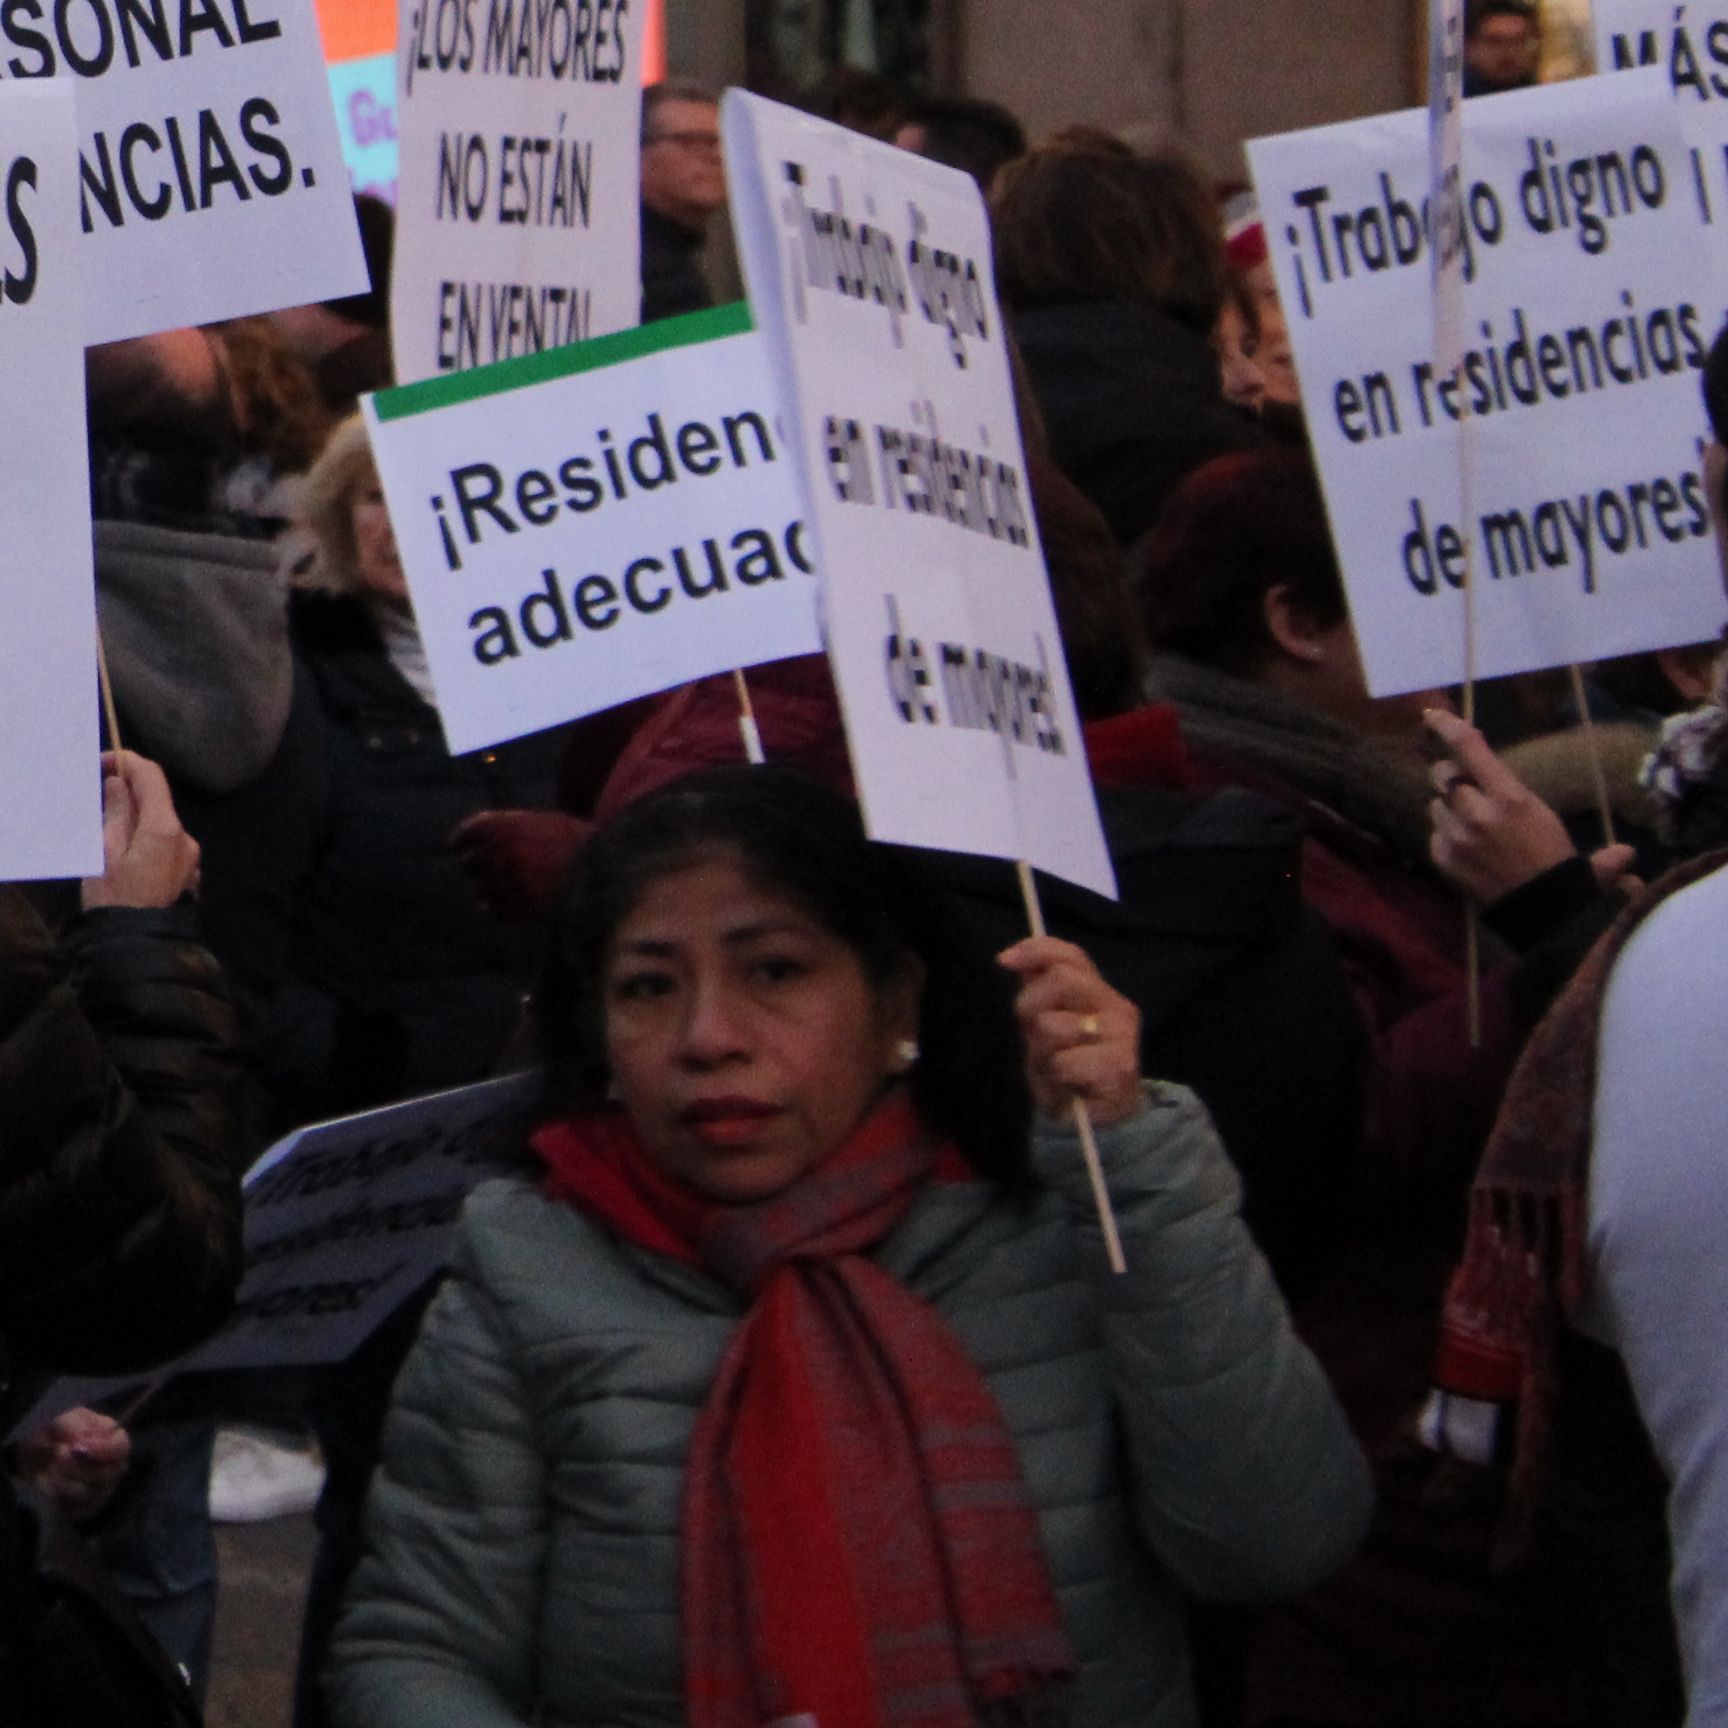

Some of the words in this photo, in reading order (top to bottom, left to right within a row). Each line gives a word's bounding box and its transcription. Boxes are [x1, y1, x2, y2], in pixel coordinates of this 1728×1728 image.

[437, 131, 489, 222] NO
[499, 110, 593, 229] ESTÁN
[1518, 136, 1666, 256] digno
[439, 281, 482, 372] EN
[781, 160, 908, 349] ¡Trabajo
[907, 201, 990, 370] digno
[1334, 369, 1401, 444] en
[1411, 289, 1706, 428] residencias
[431, 408, 784, 572] ¡Residen
[825, 414, 875, 507] en
[874, 399, 1032, 552] residencias
[1401, 496, 1468, 597] de
[884, 593, 939, 725] de
[937, 631, 1068, 782] mayores!
